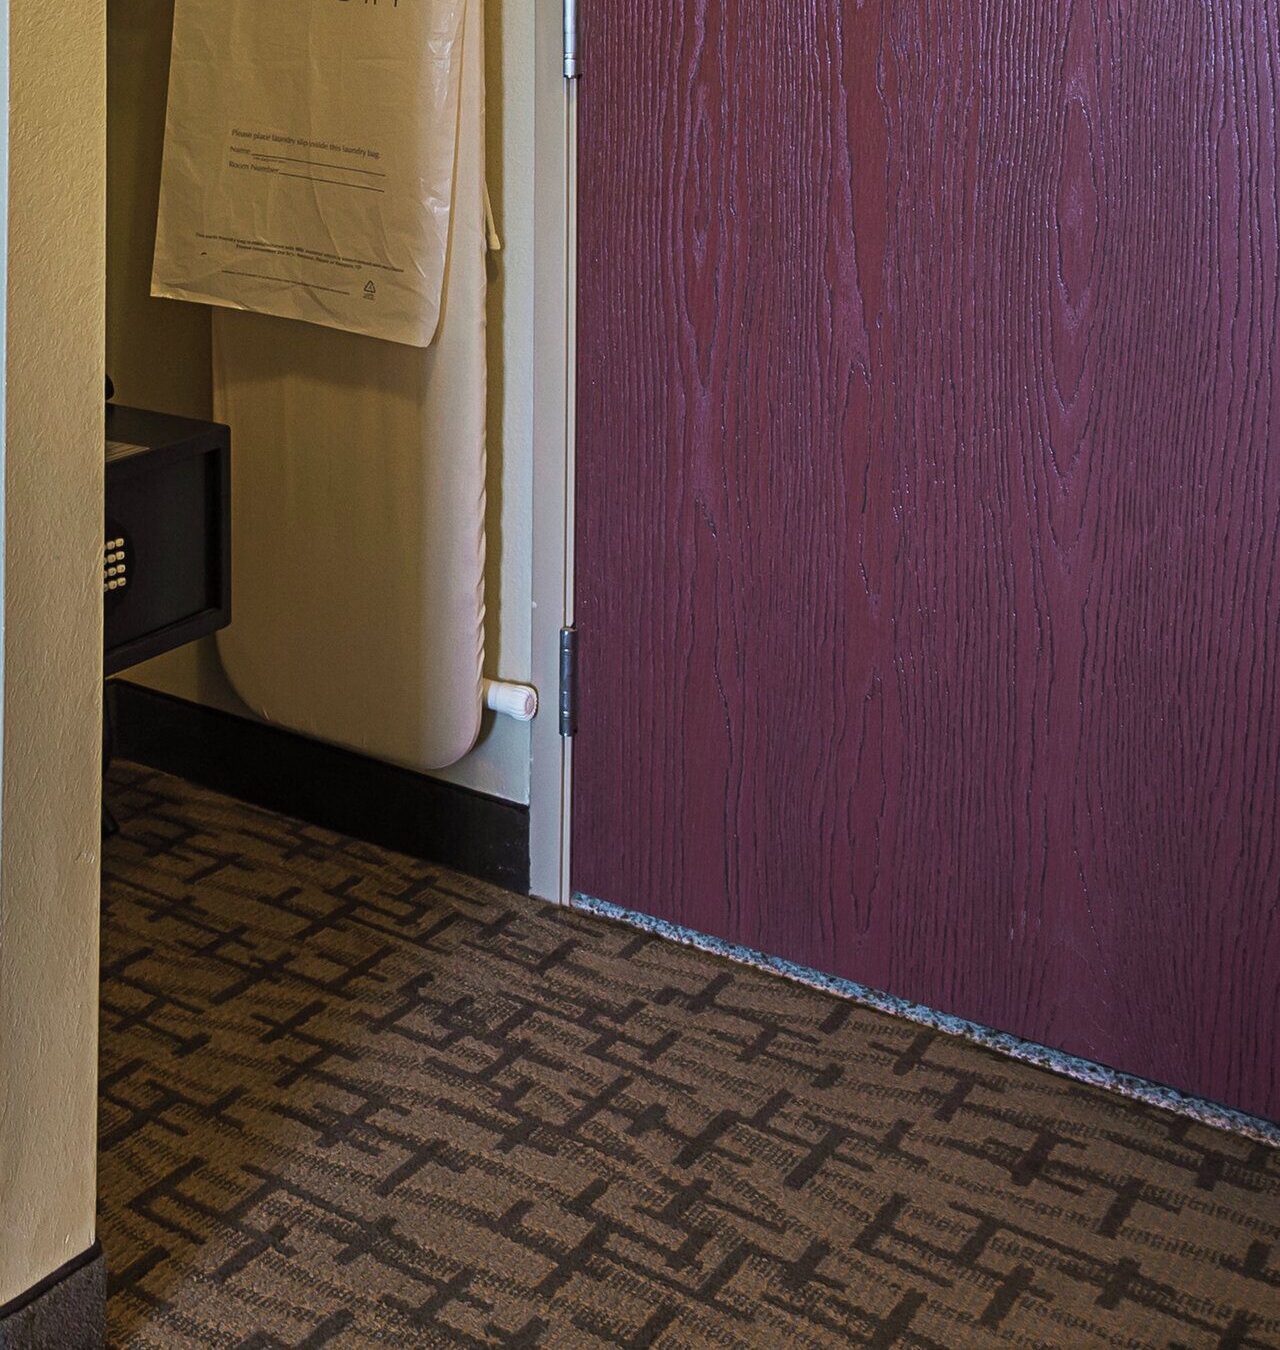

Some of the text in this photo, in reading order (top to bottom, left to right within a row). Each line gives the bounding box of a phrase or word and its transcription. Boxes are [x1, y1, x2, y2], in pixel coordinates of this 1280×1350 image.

[232, 129, 252, 138] Please
[253, 131, 271, 141] place
[272, 134, 296, 145] laundry
[297, 138, 309, 147] slip
[309, 140, 328, 149] inside
[330, 143, 341, 151] this
[342, 145, 367, 158] laundry
[230, 146, 251, 154] Name
[229, 161, 279, 173] Room Number
